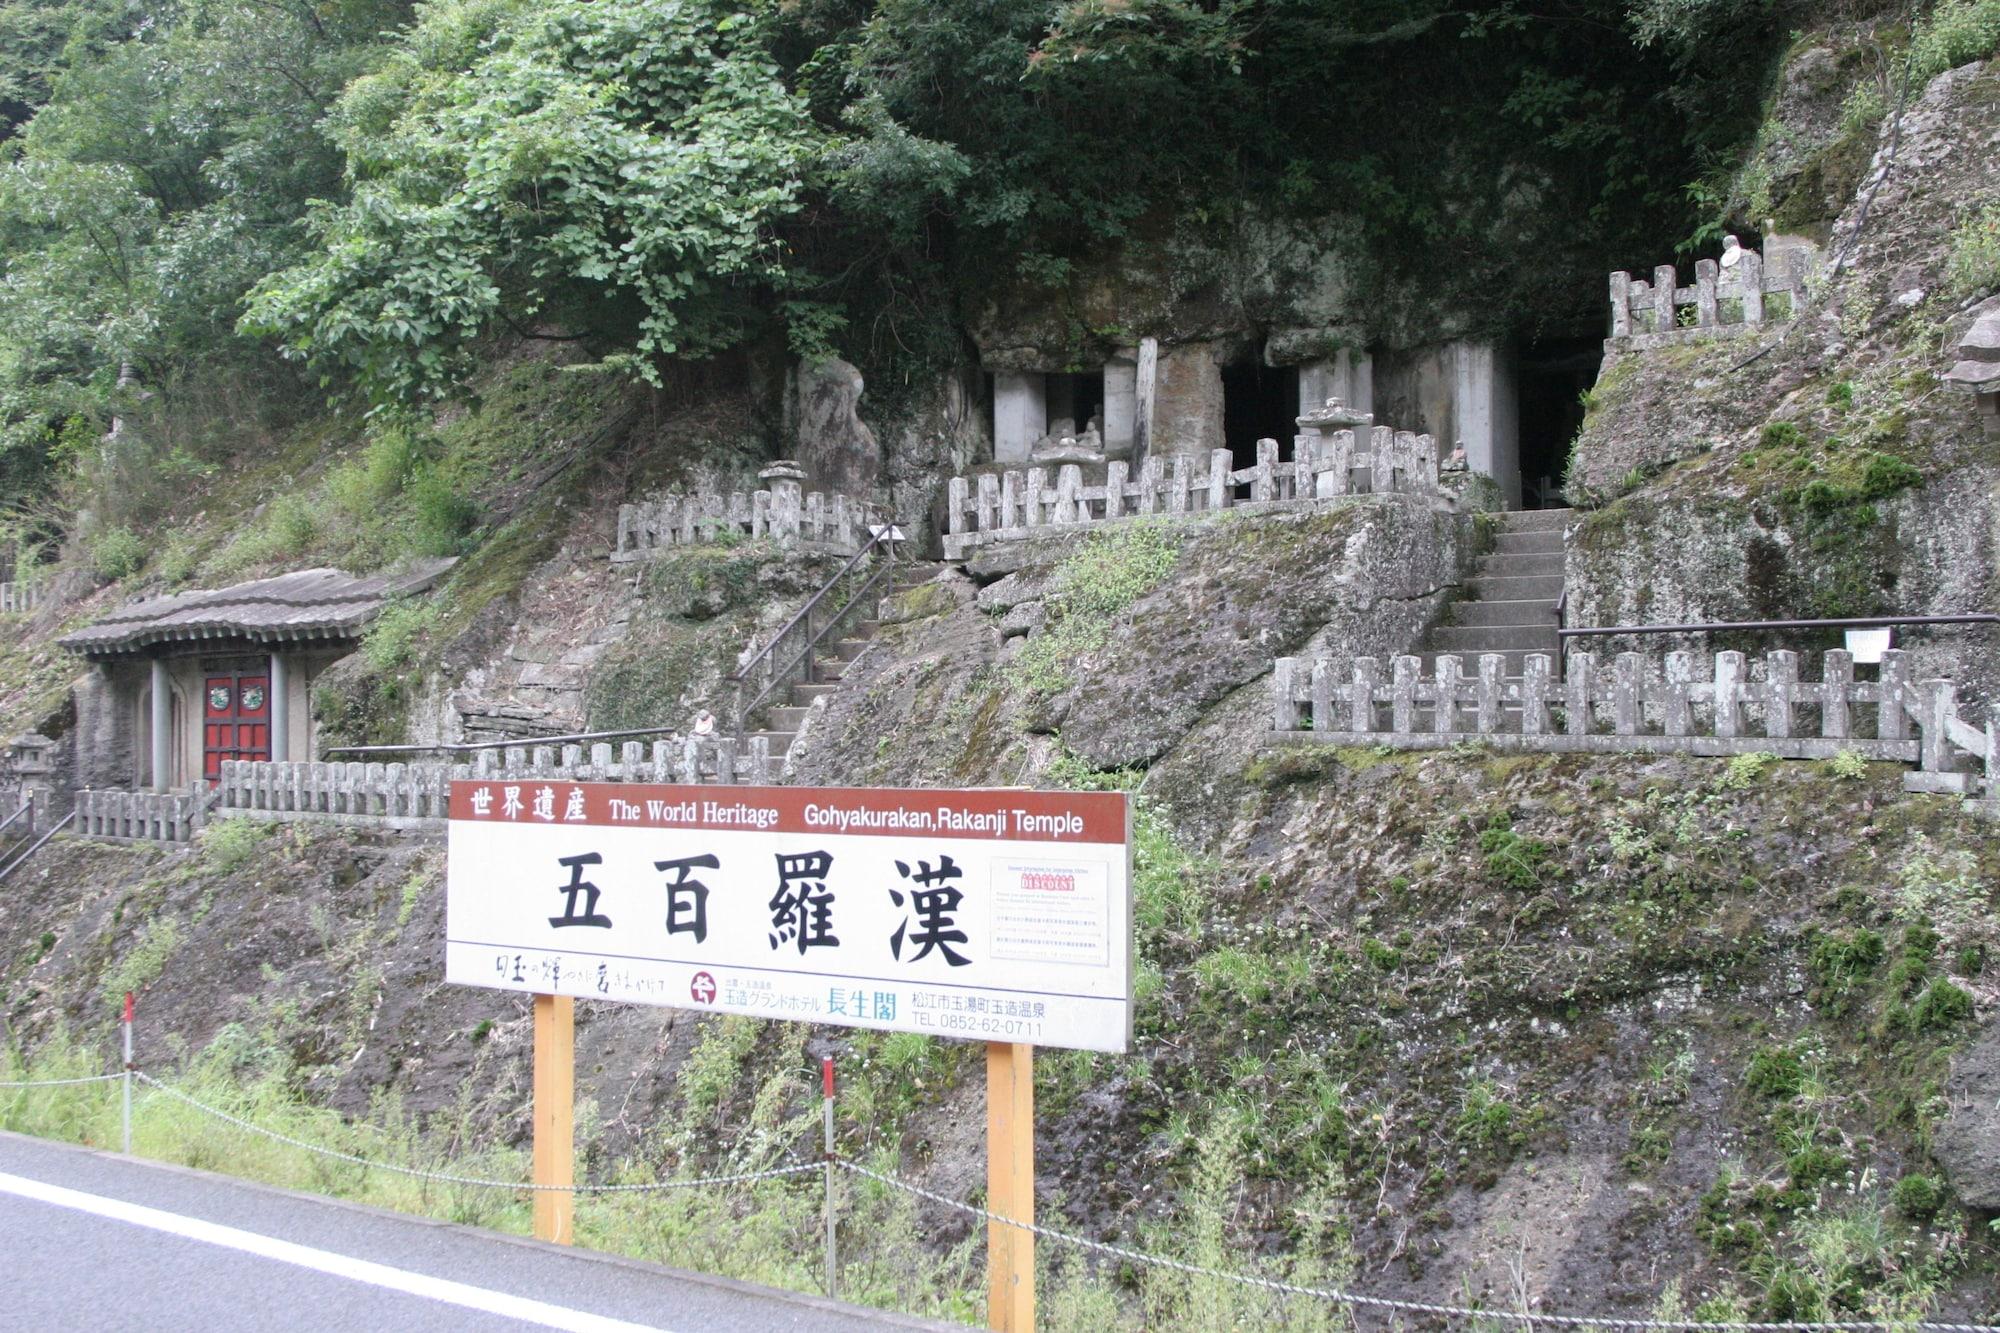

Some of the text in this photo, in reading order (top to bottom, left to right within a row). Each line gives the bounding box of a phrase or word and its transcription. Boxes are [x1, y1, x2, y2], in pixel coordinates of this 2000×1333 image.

[470, 786, 587, 820] 世界遺産
[609, 798, 779, 828] The World Heritage
[1012, 809, 1084, 838] Temple
[548, 850, 973, 968] 五百羅漢
[724, 987, 897, 1022] 玉造グランドホテル 長生閣
[912, 1011, 1043, 1037] TEL 0852-62-0711
